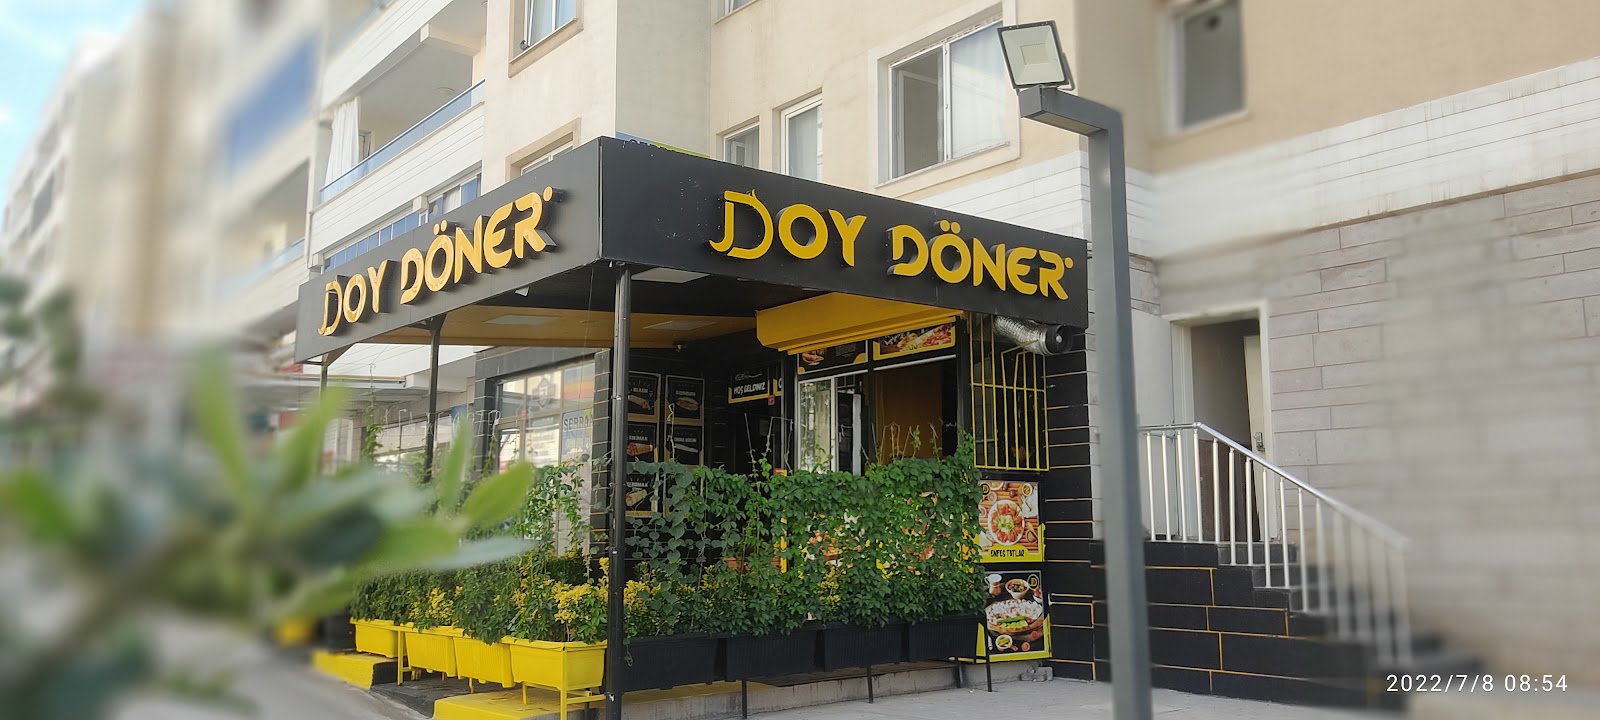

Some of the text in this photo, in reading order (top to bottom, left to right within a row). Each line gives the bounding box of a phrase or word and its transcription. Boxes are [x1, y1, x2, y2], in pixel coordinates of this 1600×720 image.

[317, 186, 553, 336] DOY DÖNER
[709, 189, 1074, 300] DOY DÖNER
